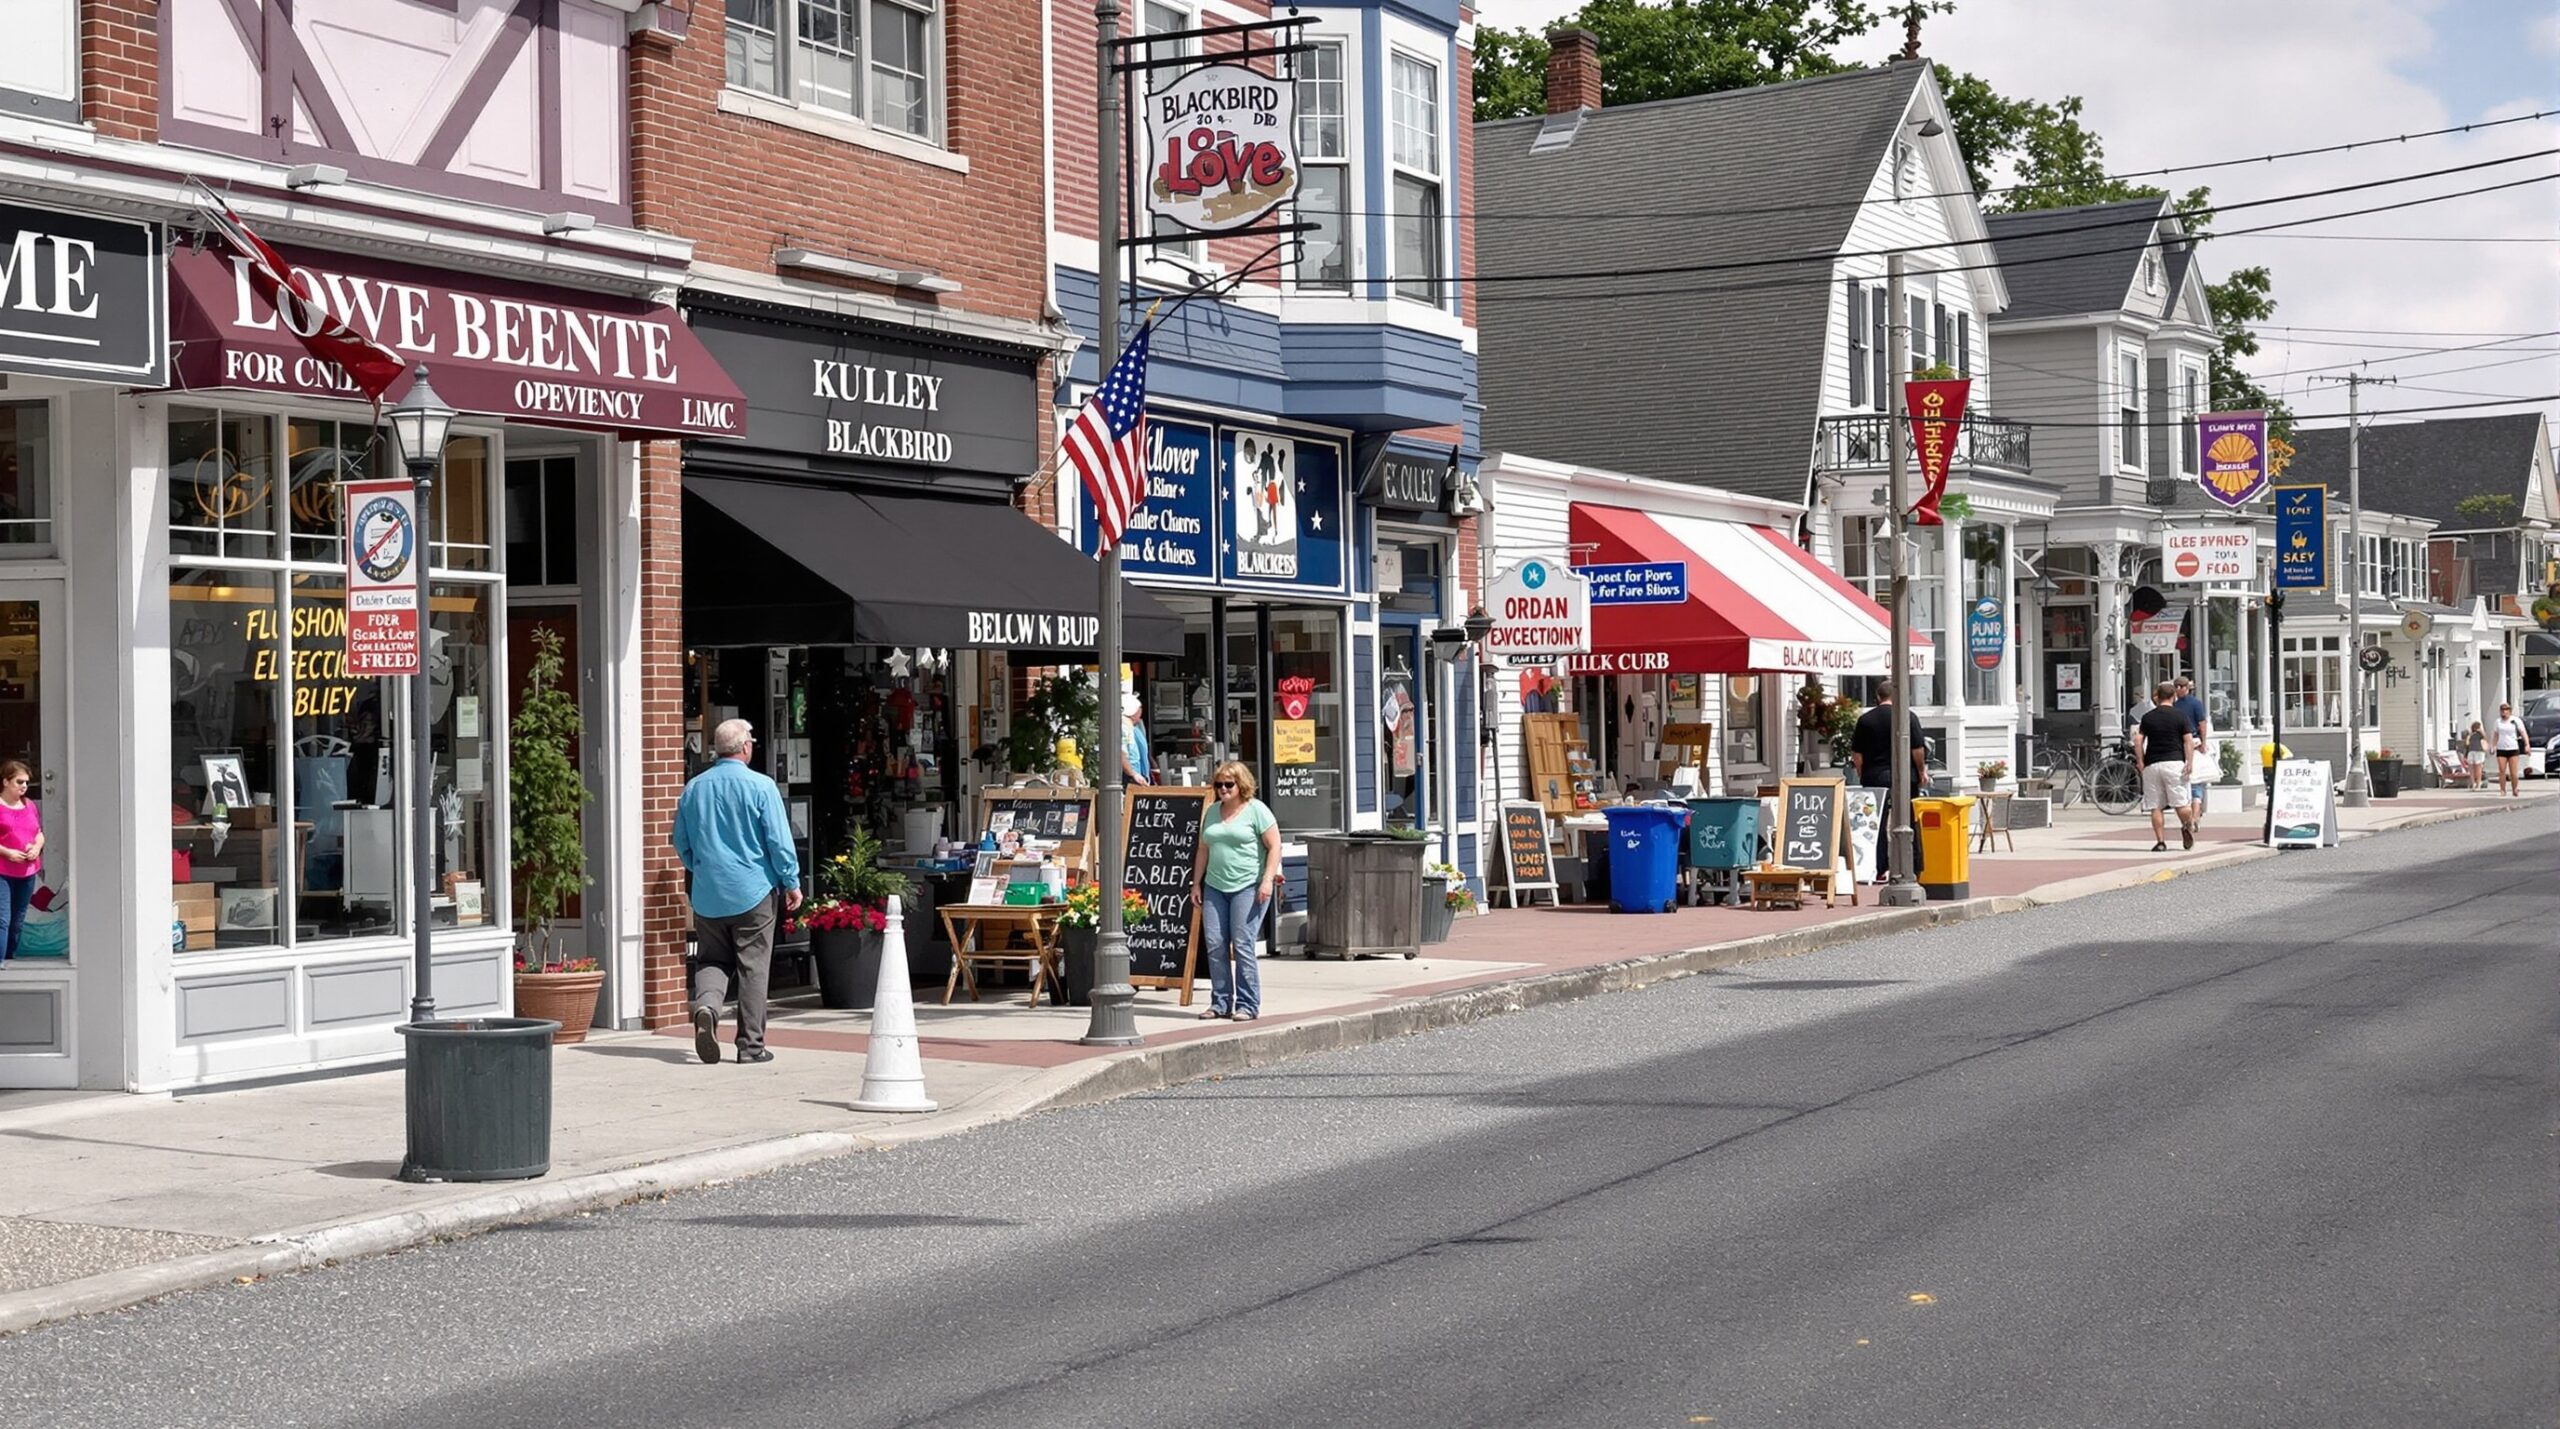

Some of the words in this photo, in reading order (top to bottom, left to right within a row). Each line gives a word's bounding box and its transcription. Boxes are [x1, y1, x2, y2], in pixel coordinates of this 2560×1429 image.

[1162, 86, 1278, 124] BLACKBIRD
[228, 255, 435, 354] LOWE
[448, 293, 678, 385] BEENTE
[226, 350, 286, 384] FOR
[515, 379, 644, 420] OPEVIENCY
[813, 359, 943, 411] KULLEY
[827, 419, 953, 463] BLACKBIRD
[1625, 569, 1643, 583] for
[1505, 597, 1568, 620] ORDAN
[361, 652, 417, 668] FREED
[1618, 652, 1670, 670] CURB
[1783, 646, 1818, 667] BLACK
